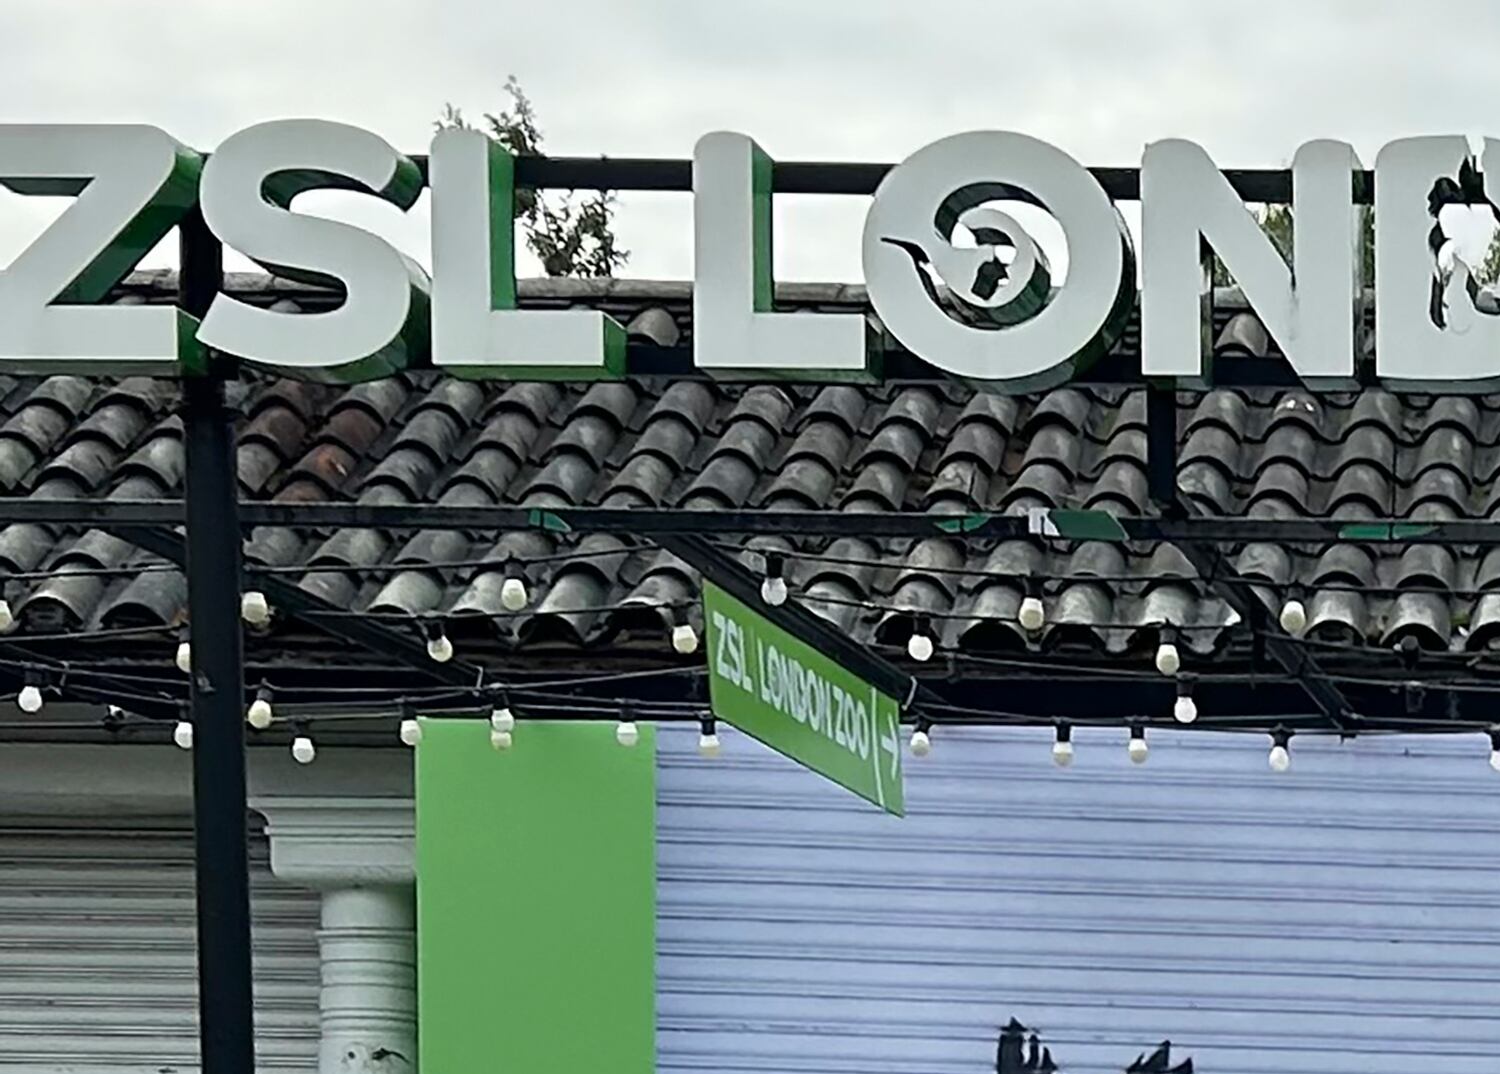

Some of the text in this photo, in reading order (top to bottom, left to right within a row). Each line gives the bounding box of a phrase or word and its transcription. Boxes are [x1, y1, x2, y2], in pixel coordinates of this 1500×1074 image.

[0, 118, 614, 372] ZSL
[712, 610, 870, 761] ZSL LONDON ZOO
